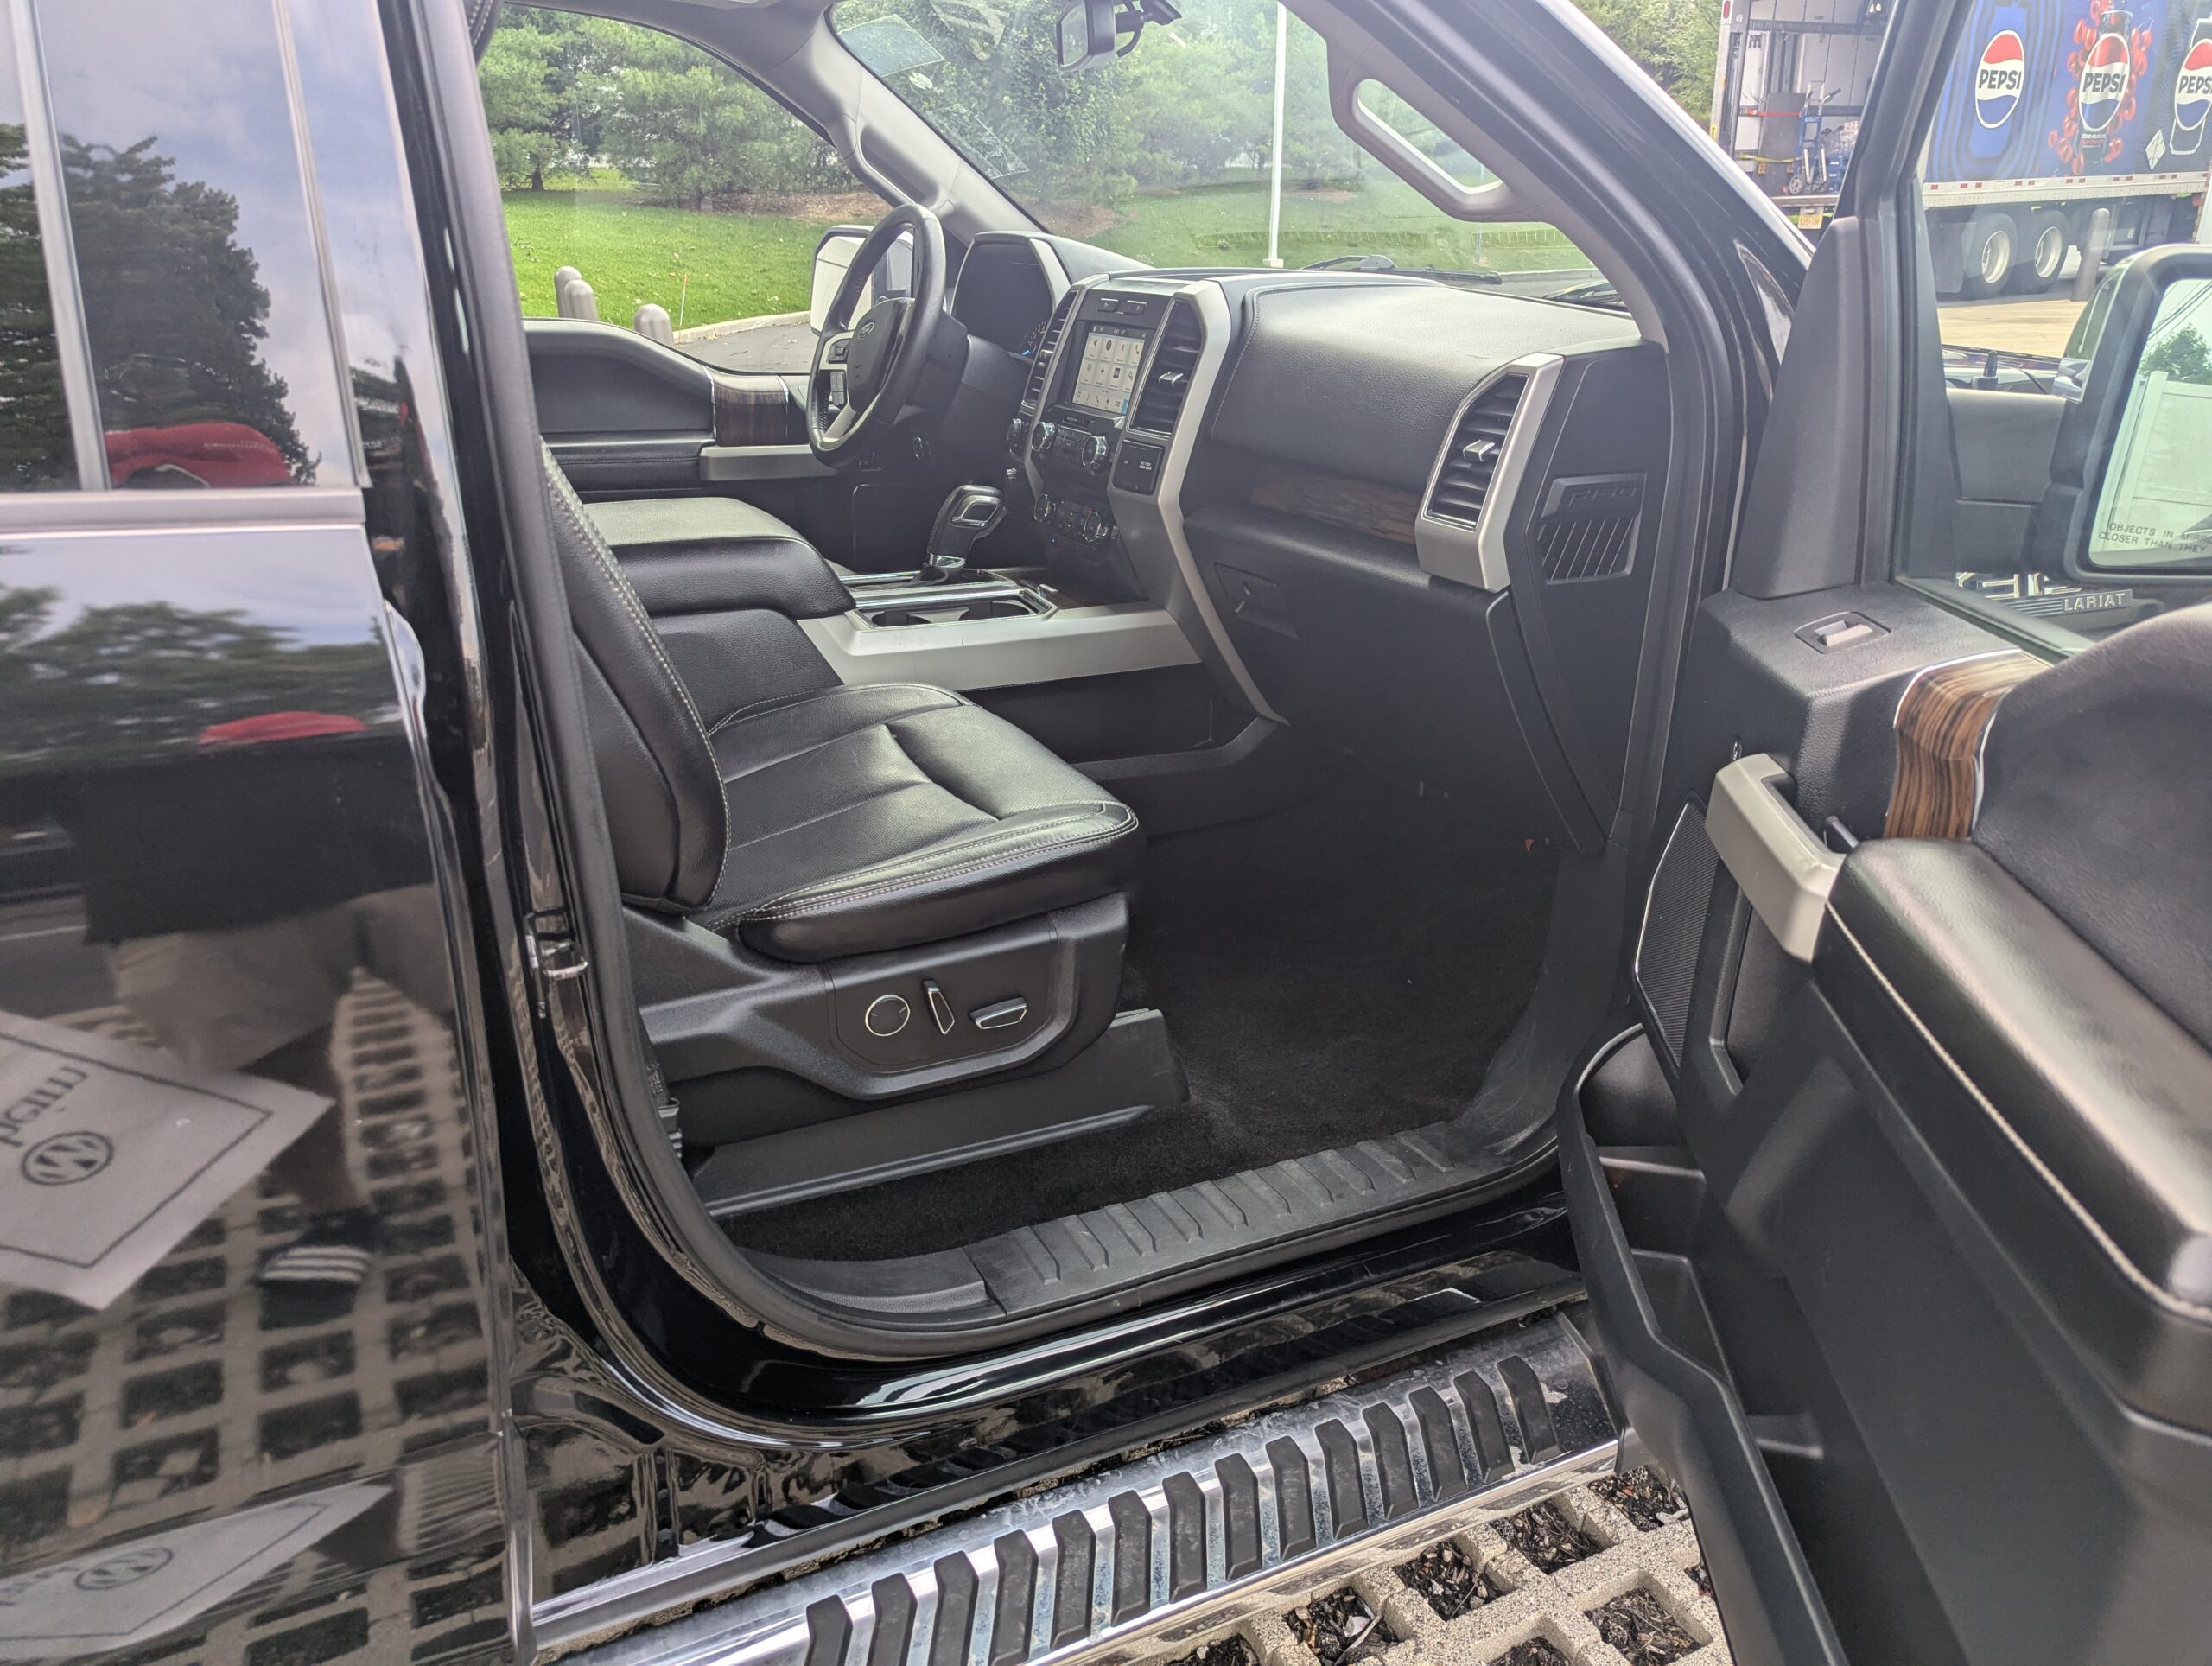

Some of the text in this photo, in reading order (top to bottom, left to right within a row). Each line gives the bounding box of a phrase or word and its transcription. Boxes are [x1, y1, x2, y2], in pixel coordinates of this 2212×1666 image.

[1978, 69, 2022, 90] PEPSI
[2082, 73, 2126, 93] PEPSI
[2177, 75, 2212, 95] PEPS
[2109, 522, 2156, 537] OBJECTS
[2163, 530, 2174, 538] IN
[2099, 531, 2207, 553] CLOSER THAN THEY
[2064, 593, 2126, 611] LARIAT
